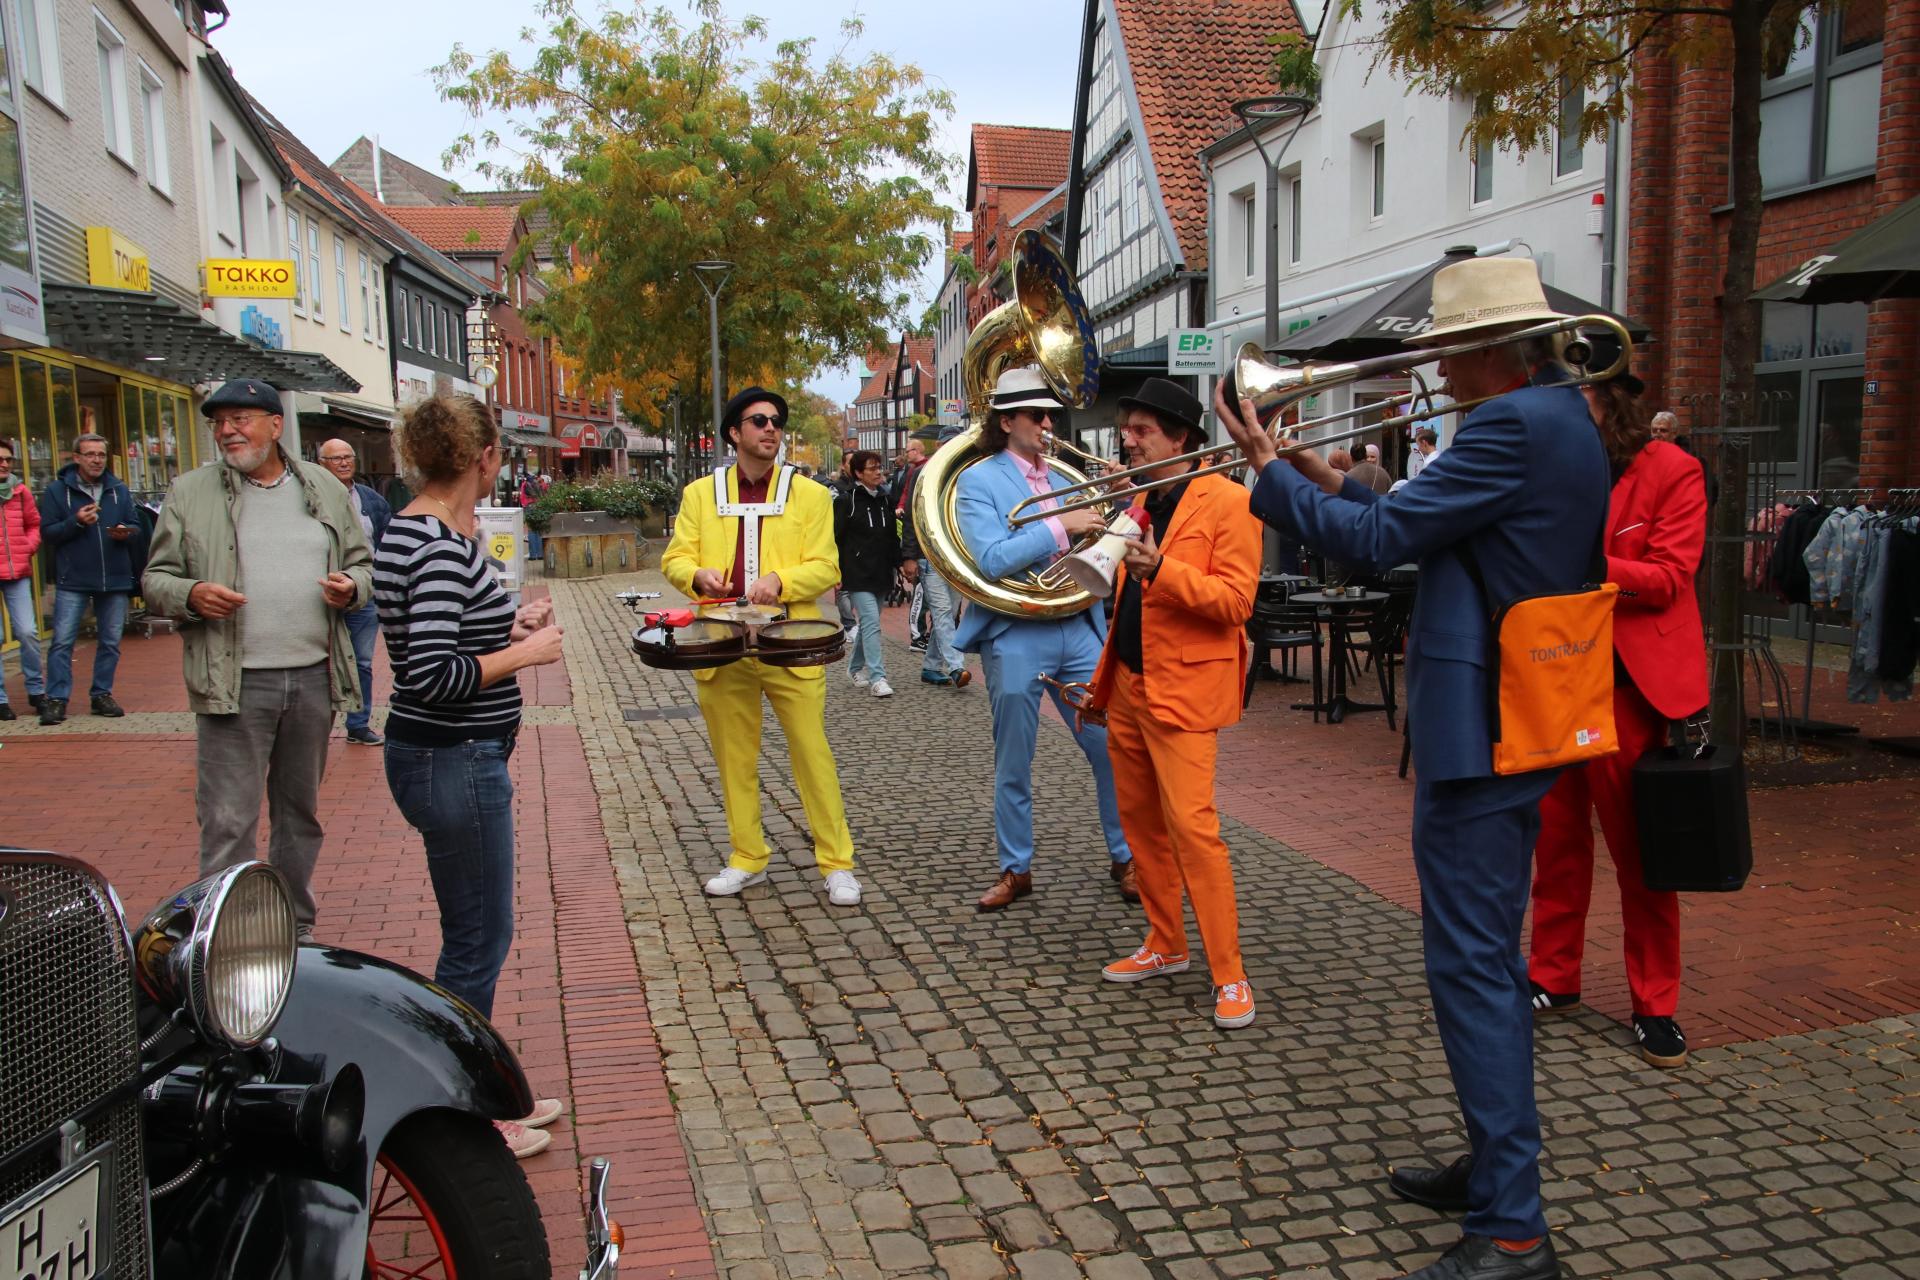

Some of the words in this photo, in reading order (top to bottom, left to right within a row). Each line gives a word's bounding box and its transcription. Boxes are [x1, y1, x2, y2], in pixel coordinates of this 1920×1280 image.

[1376, 315, 1434, 333] Tch
[1178, 334, 1213, 351] EP:
[945, 402, 957, 410] dm
[16, 1207, 44, 1273] H
[20, 1228, 90, 1280] 7H
